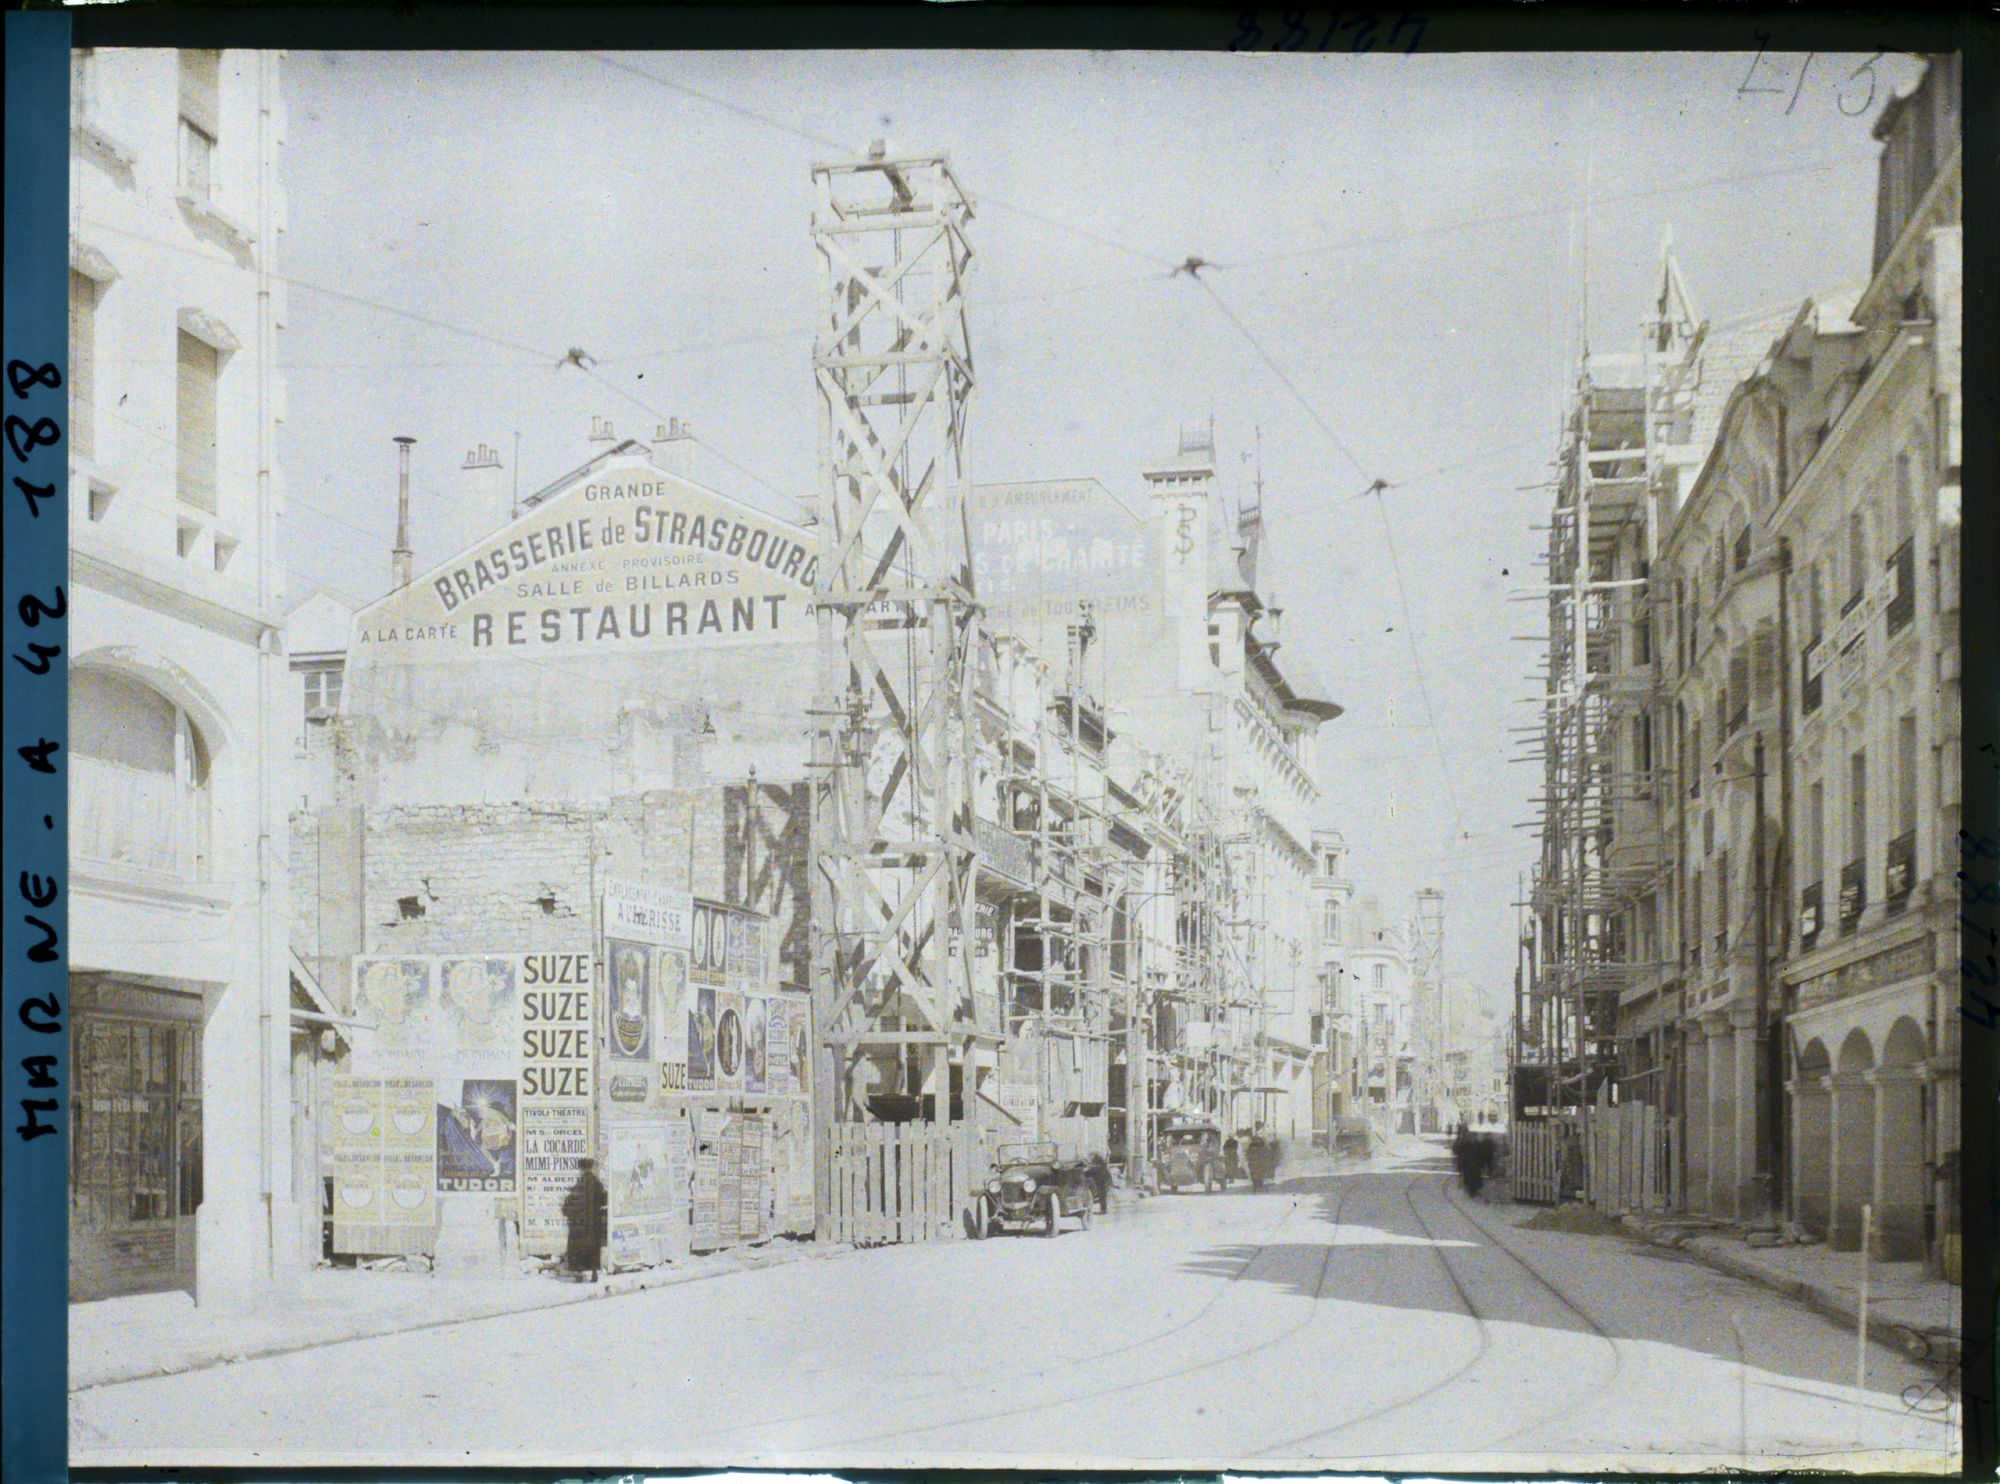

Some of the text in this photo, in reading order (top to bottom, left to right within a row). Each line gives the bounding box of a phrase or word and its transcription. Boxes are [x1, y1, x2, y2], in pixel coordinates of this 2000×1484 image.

[3, 357, 62, 518] 188
[584, 481, 666, 501] GRANDE
[433, 505, 818, 611] BRASSERIE de STRASBOURG
[551, 554, 704, 573] ANNEXE PROVISOIRE
[516, 569, 739, 598] SALLE de BILLARDS
[12, 584, 66, 676] 42
[361, 624, 459, 643] A LA CARTE
[473, 594, 787, 647] RESTAURANT
[523, 955, 589, 984] SUZE
[14, 868, 60, 1142] MARNE
[523, 992, 589, 1021] SUZE
[523, 1029, 589, 1058] SUZE
[522, 1067, 589, 1096] SUZE
[662, 1062, 686, 1089] SUZE
[526, 1139, 586, 1153] LA COCARDE
[439, 1178, 514, 1191] TUDOR
